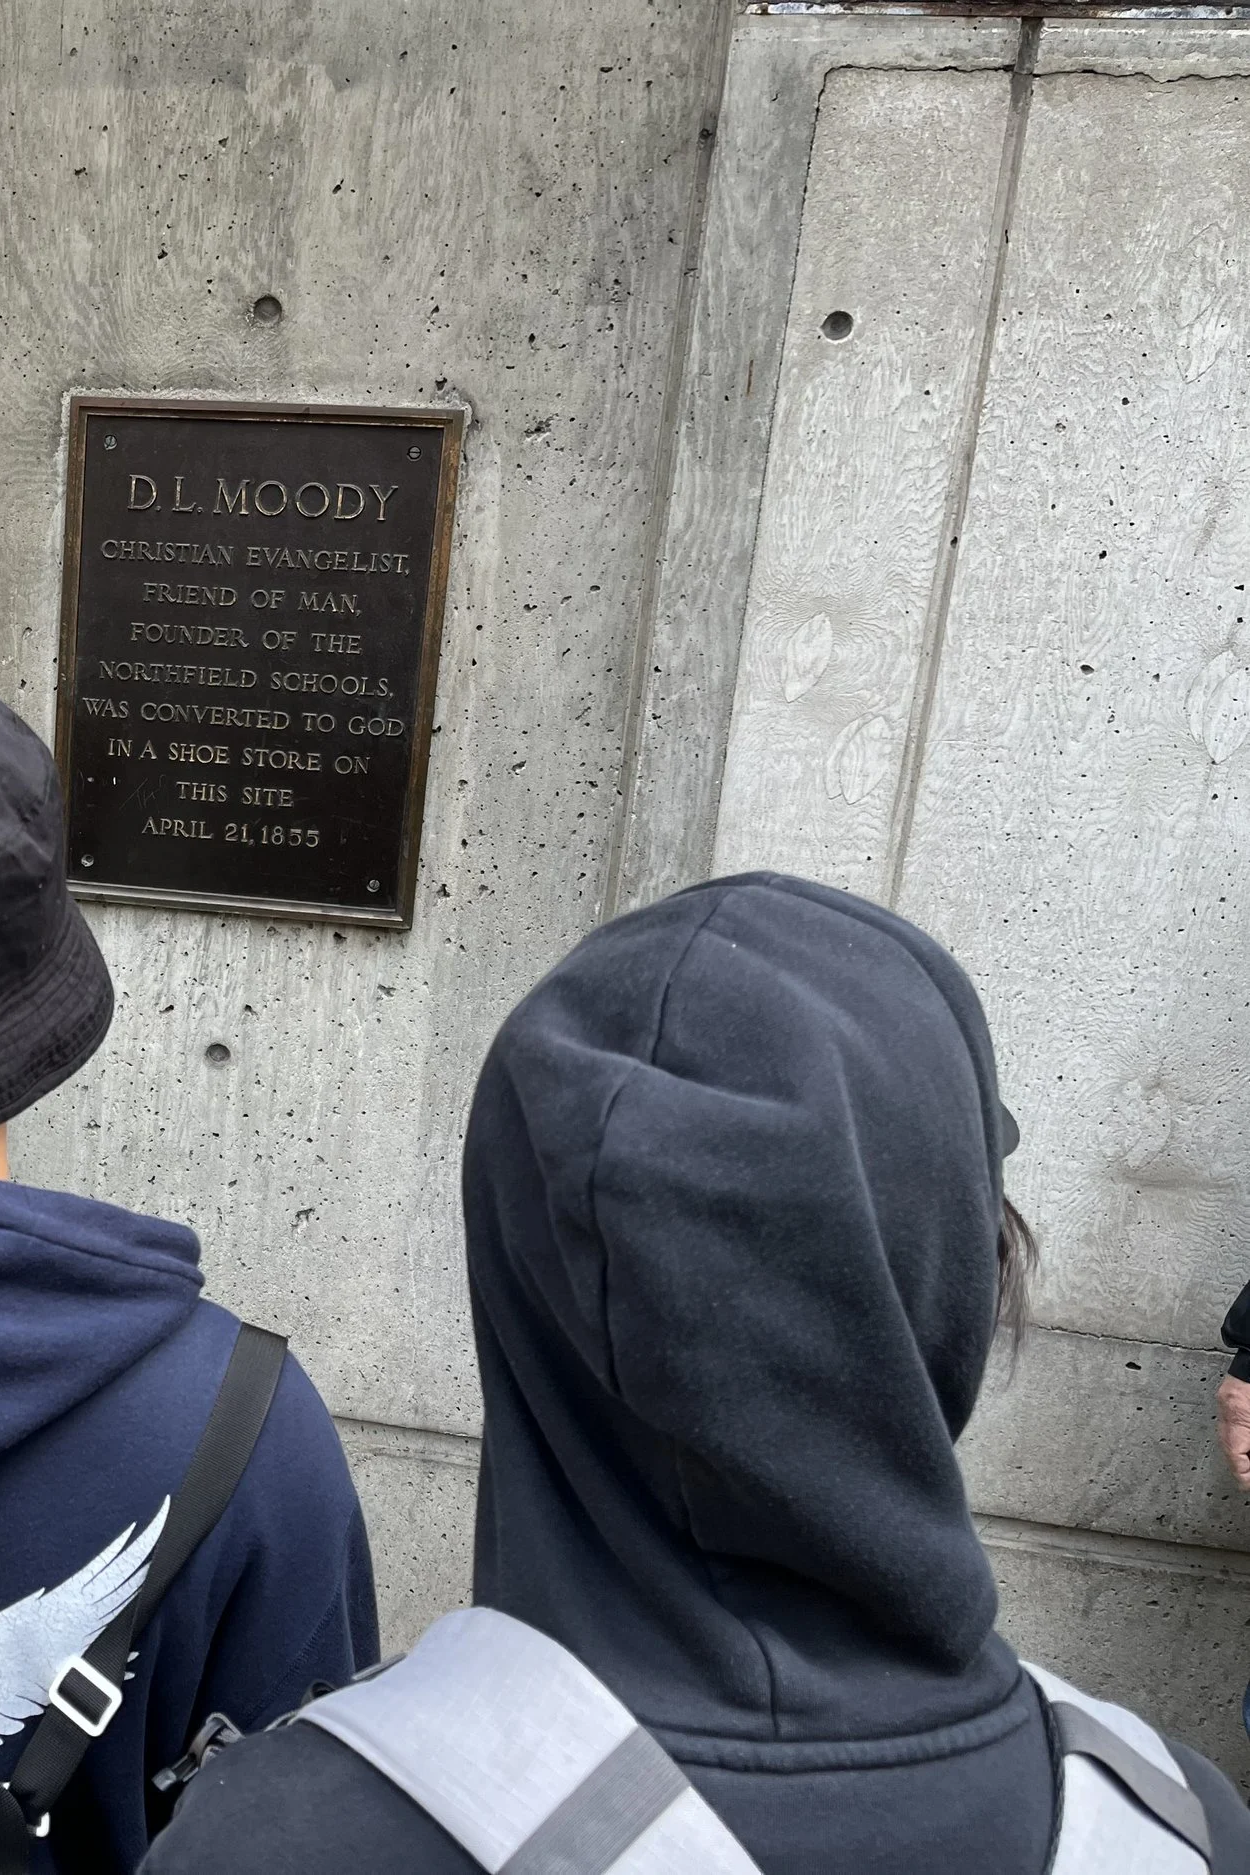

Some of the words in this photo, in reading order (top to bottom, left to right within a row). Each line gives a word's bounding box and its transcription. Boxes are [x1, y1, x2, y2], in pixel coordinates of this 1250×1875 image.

[213, 478, 398, 521] MOODY
[101, 539, 235, 566] CHRISTIAN
[246, 546, 410, 576] EVANGELIST,
[143, 582, 238, 606] FRIEND
[251, 589, 285, 610] OF
[298, 591, 363, 617] MAN,
[130, 622, 249, 648] FOUNDER
[262, 629, 297, 651] OF
[311, 632, 363, 655] THE
[99, 661, 257, 689] NORTHFIELD
[83, 697, 129, 720] WAS
[140, 703, 290, 731] CONVERTED
[302, 712, 335, 733] TO
[348, 716, 405, 737] GOD
[108, 738, 132, 757] IN
[138, 740, 157, 760] A
[169, 742, 230, 765] SHOE
[241, 749, 321, 772] STORE
[334, 755, 370, 775] ON
[176, 781, 227, 803] THIS
[243, 787, 294, 808] SITE
[141, 816, 214, 840] APRIL
